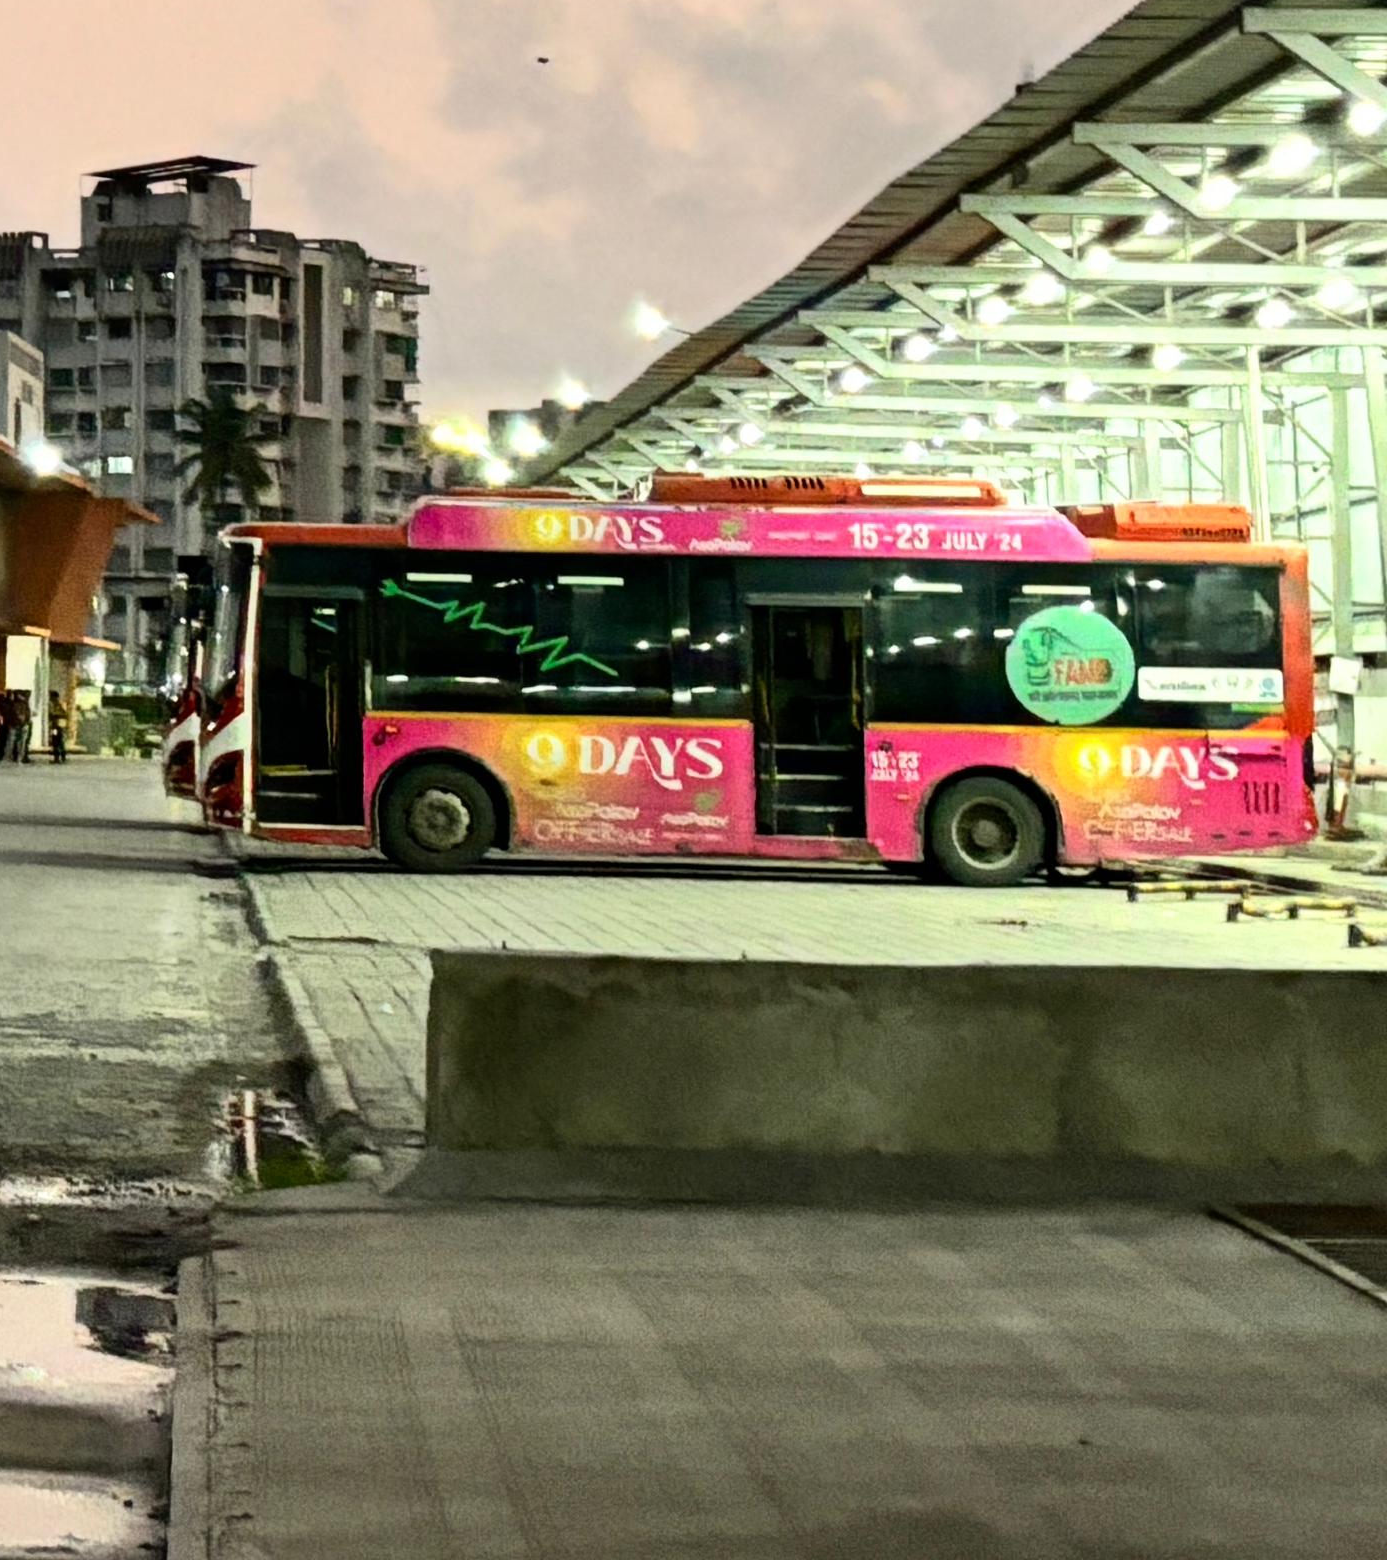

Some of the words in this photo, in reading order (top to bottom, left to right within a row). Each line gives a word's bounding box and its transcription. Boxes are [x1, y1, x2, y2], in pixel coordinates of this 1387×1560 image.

[569, 515, 665, 550] DAYS
[848, 523, 931, 550] 15-23
[940, 530, 988, 551] JULY
[579, 734, 725, 791] DAYS
[1120, 744, 1240, 790] DAYS
